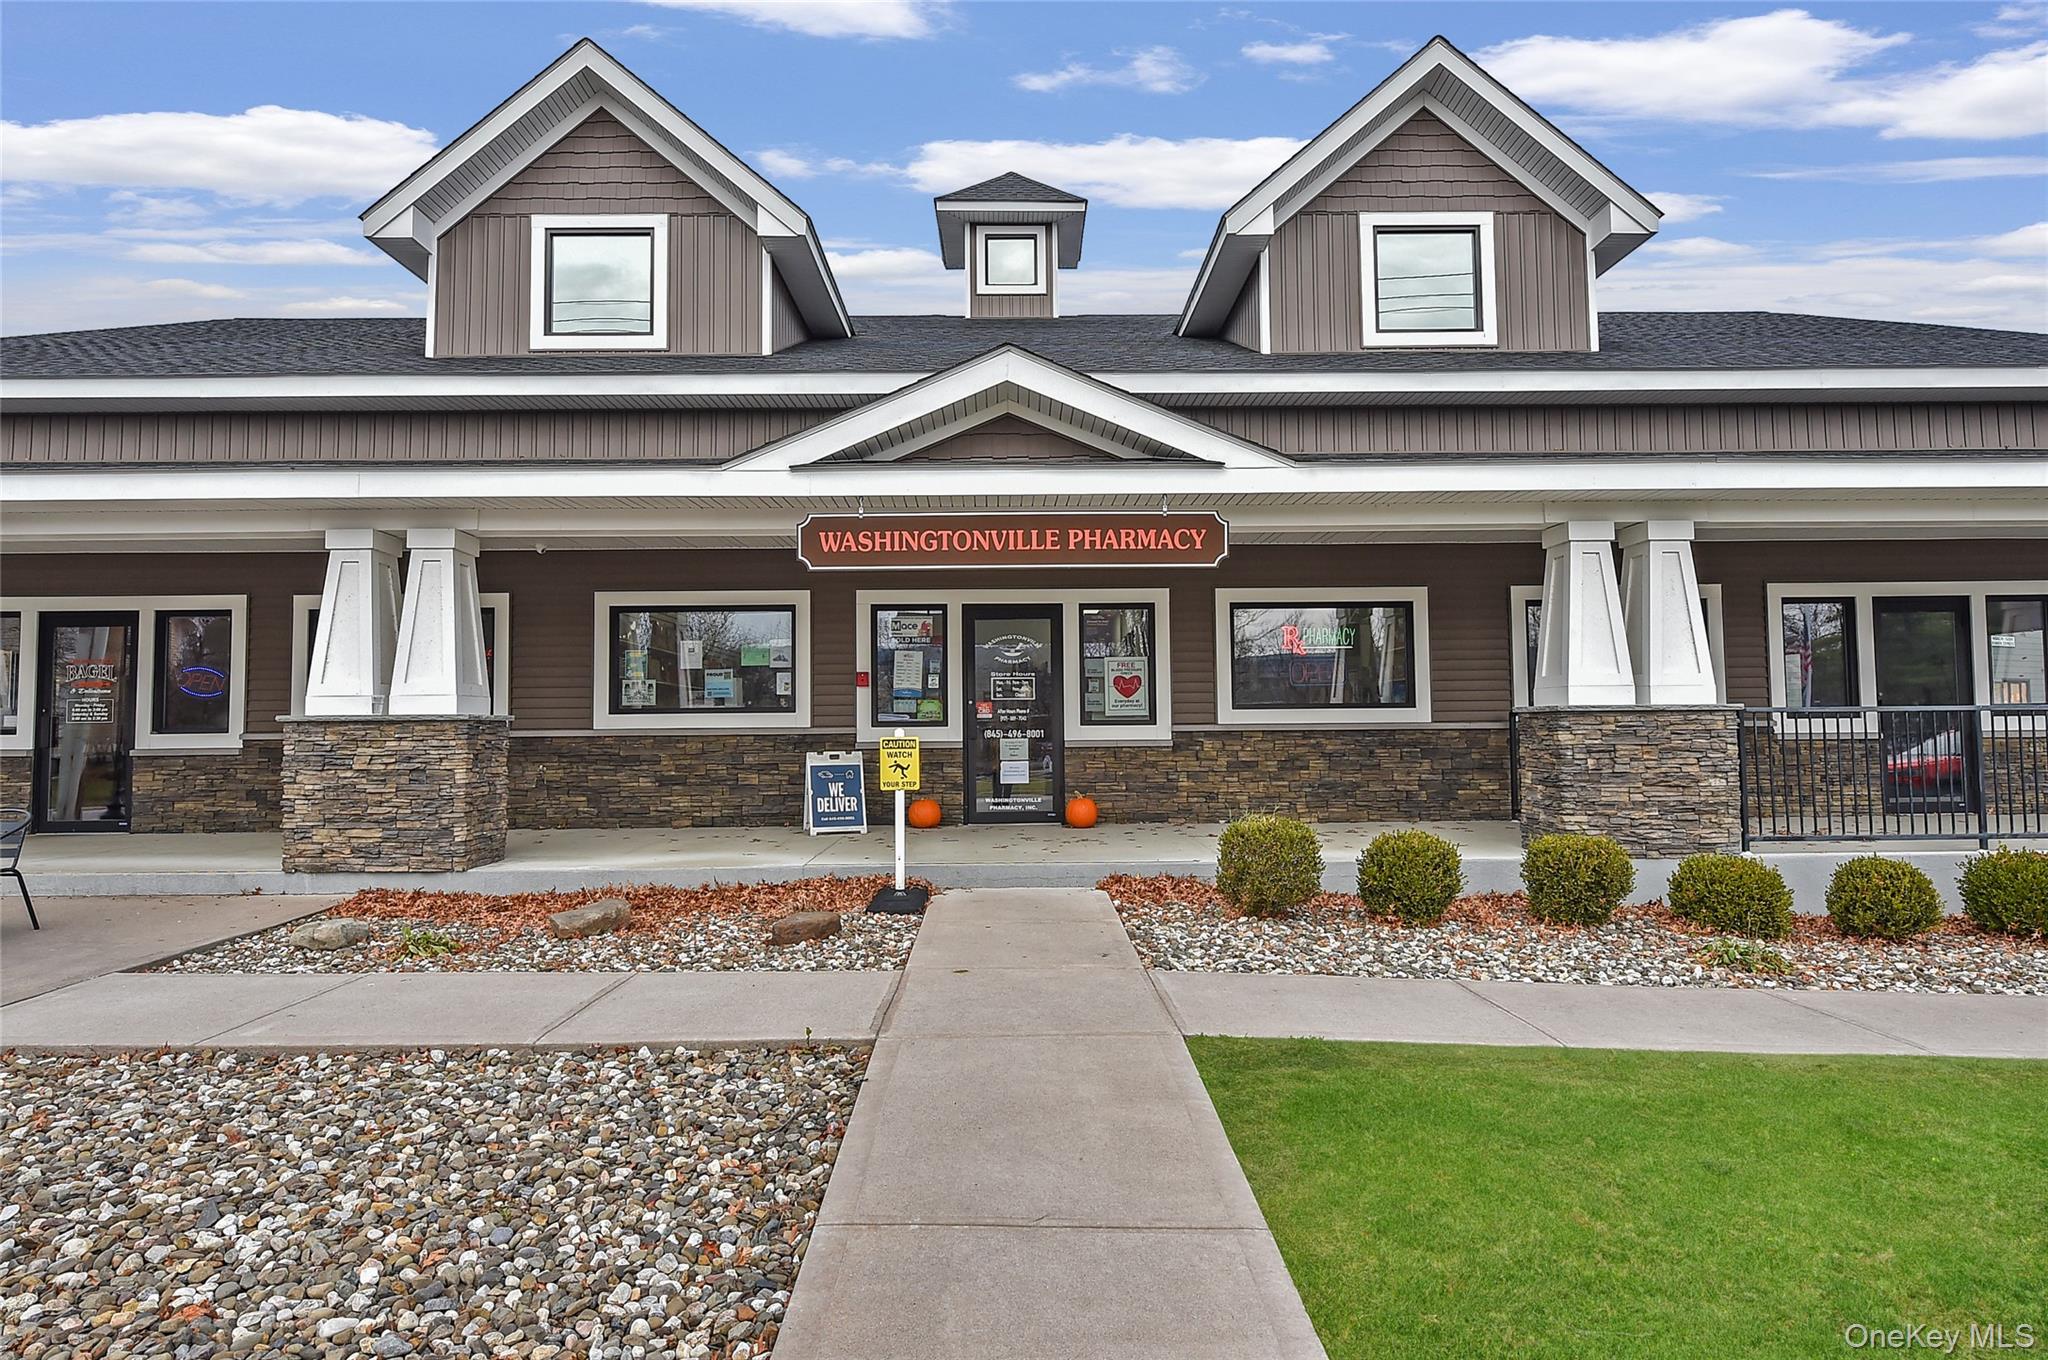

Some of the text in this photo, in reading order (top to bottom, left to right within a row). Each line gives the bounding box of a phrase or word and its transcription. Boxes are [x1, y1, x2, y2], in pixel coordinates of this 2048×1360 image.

[818, 527, 1207, 553] WASHINGTONVILLE PHARMACY
[891, 621, 918, 631] Mace
[983, 634, 1043, 649] WASHINGTONVILLE
[1302, 626, 1356, 646] PHARMACY
[994, 656, 1031, 664] PHARMACY
[65, 664, 117, 682] BAGEL
[177, 672, 225, 691] OPEN
[984, 729, 1044, 738] (845)-496-8001
[882, 740, 916, 748] CAUTION
[828, 782, 845, 797] WE
[882, 780, 917, 788] YOUR STEP
[816, 797, 858, 813] DELIVER
